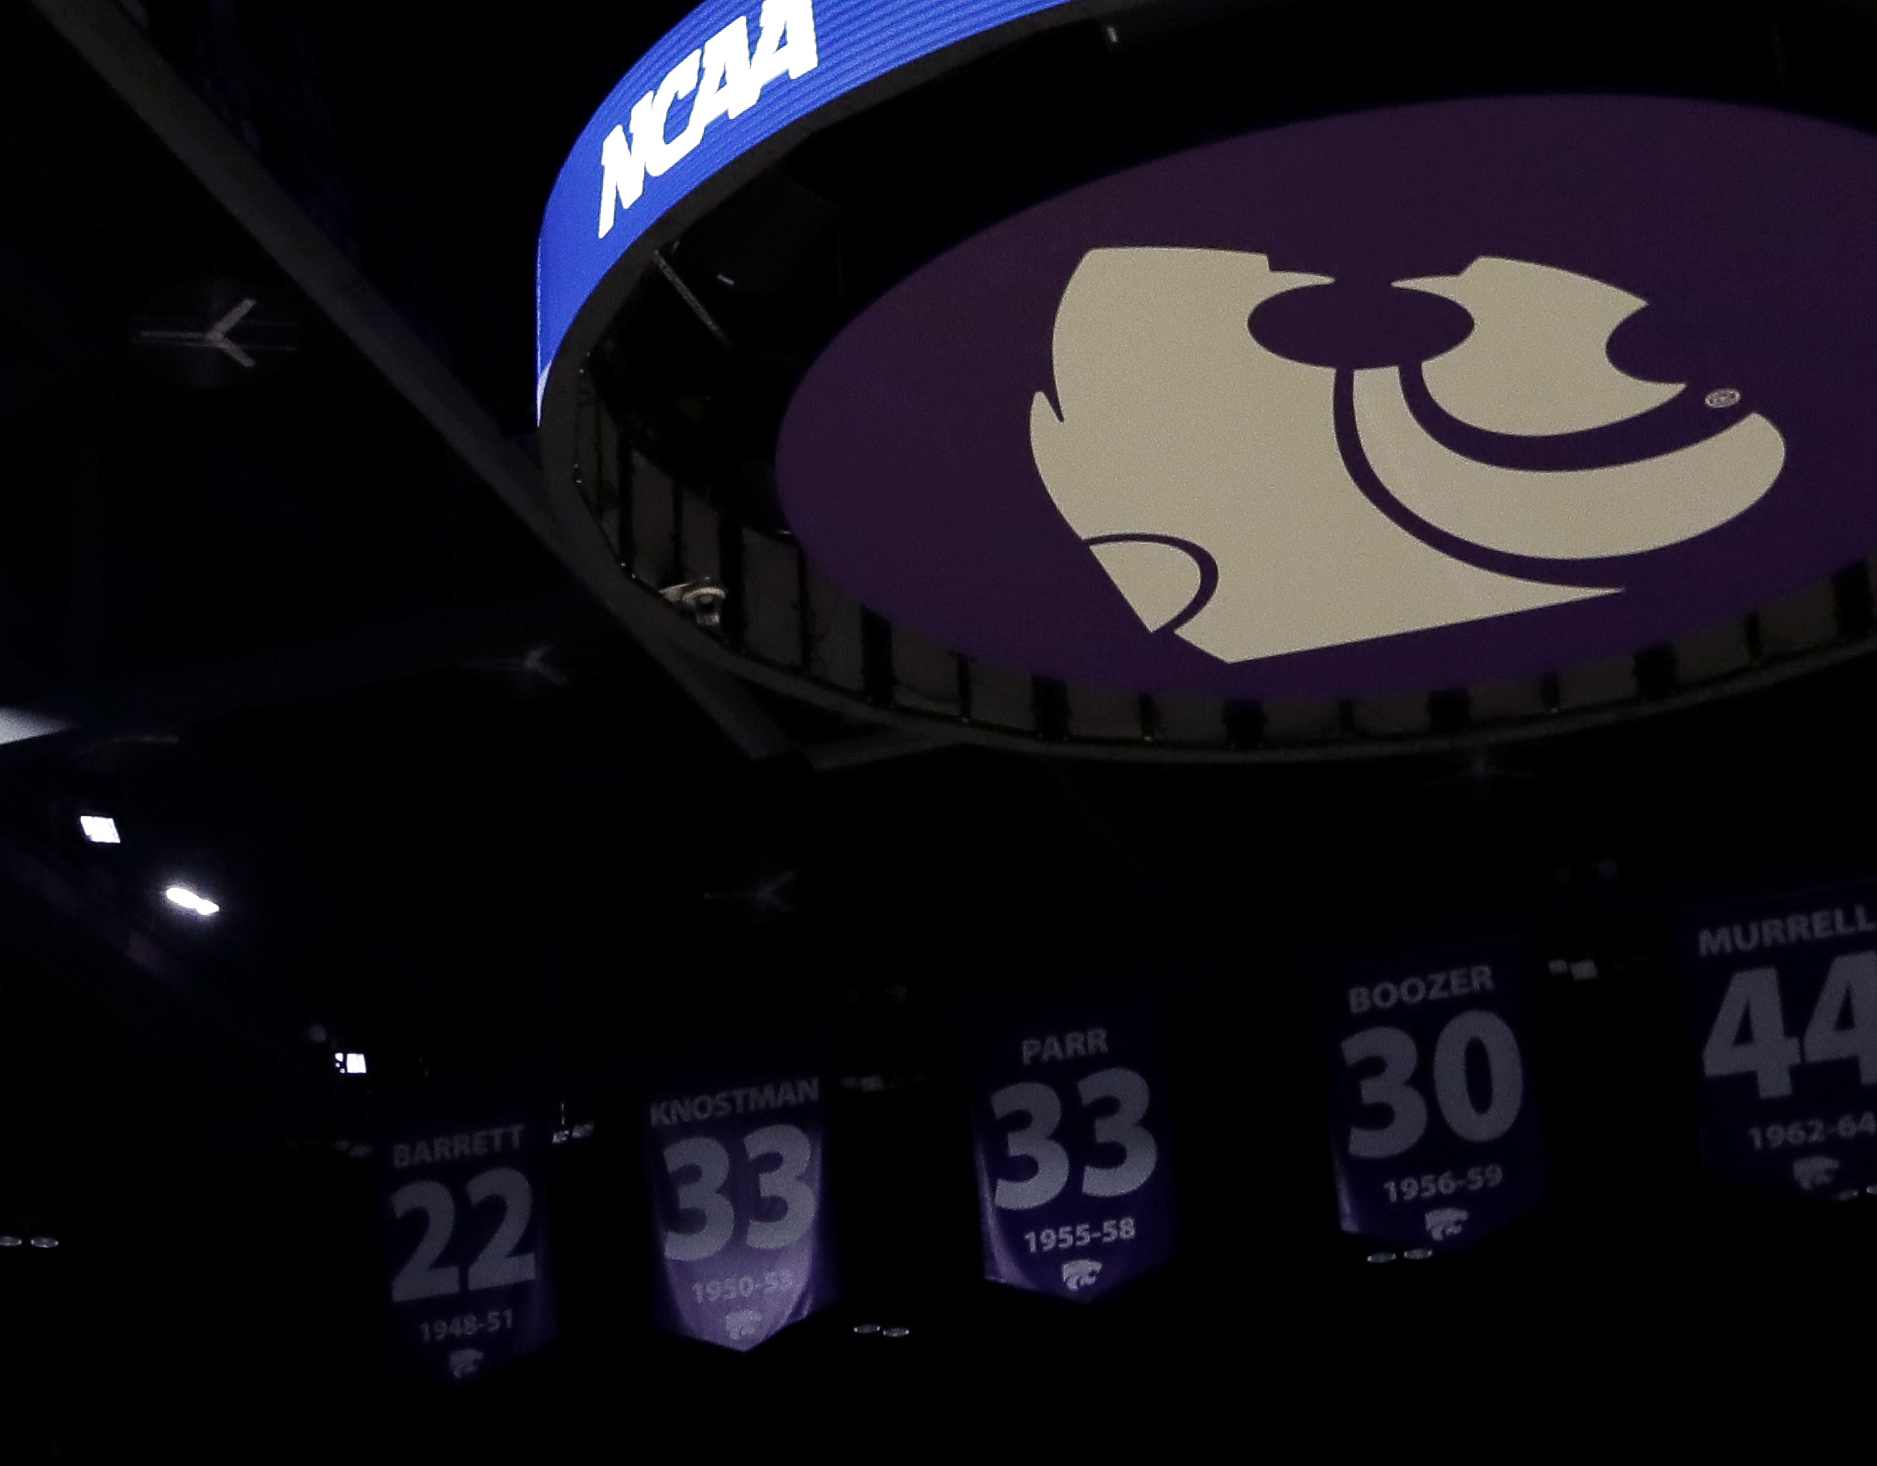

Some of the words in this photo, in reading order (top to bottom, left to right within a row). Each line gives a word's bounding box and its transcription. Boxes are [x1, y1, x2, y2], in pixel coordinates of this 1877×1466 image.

[598, 0, 818, 239] NCAA
[1697, 903, 1877, 958] MURRELL
[1348, 964, 1495, 1016] BOOZER
[1021, 1027, 1110, 1067] PARR
[1701, 949, 1877, 1101] 44
[650, 1075, 820, 1128] KNOSTMAN
[1340, 1008, 1524, 1160] 30
[391, 1123, 527, 1170] BARRETT
[989, 1067, 1159, 1211] 33
[1747, 1110, 1877, 1152] 1962-64
[663, 1123, 817, 1262] 33
[1383, 1162, 1504, 1204] 1956-59
[390, 1166, 536, 1304] 22
[1023, 1216, 1137, 1254] 1955-58
[418, 1308, 514, 1344] 1948-51
